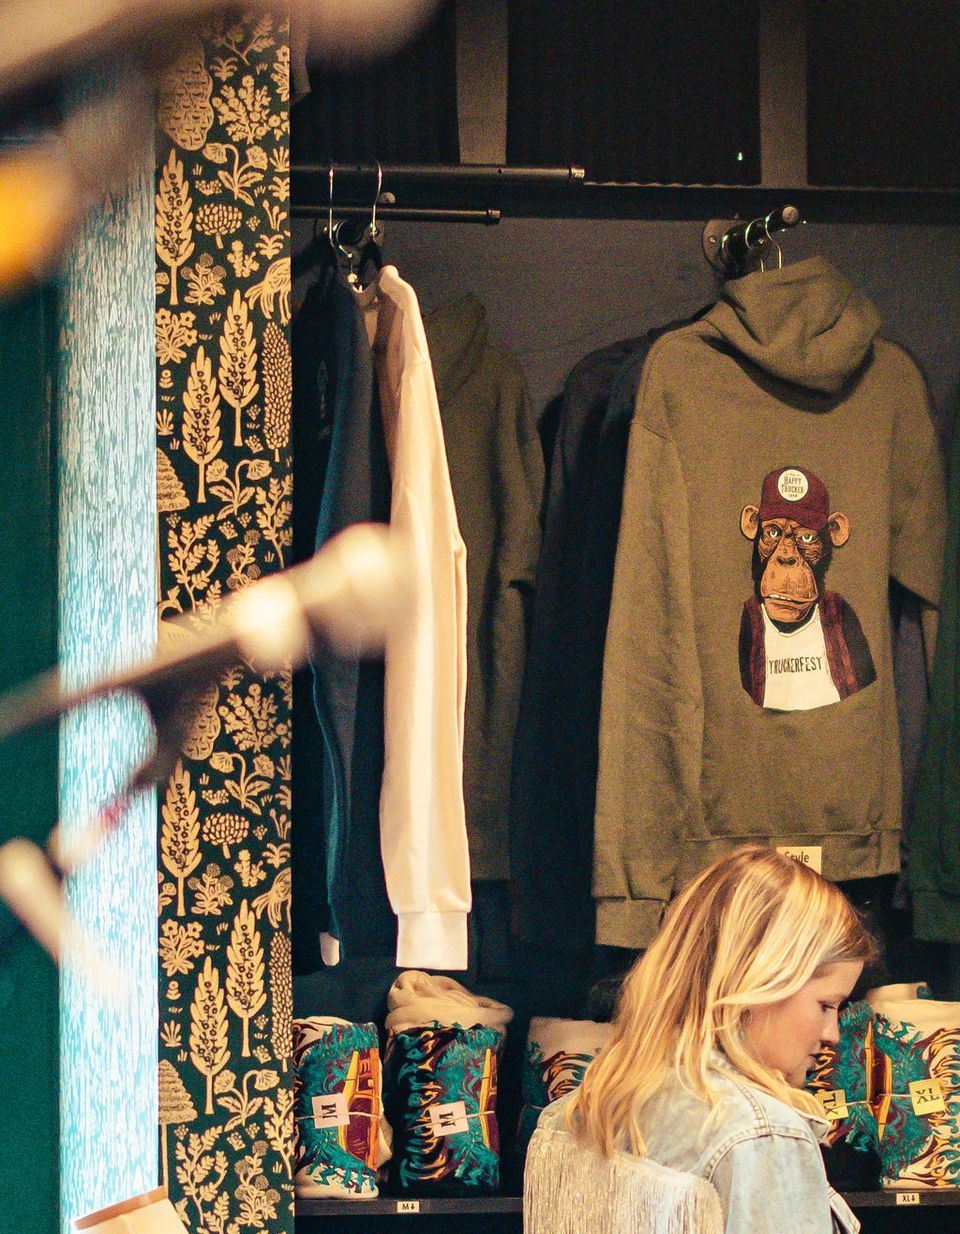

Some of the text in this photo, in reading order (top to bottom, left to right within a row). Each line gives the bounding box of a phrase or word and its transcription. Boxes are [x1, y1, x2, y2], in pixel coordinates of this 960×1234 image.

[781, 485, 804, 494] TRUCKER
[768, 655, 823, 676] TRUCKERFEST
[321, 1104, 338, 1119] M
[439, 1111, 457, 1128] M
